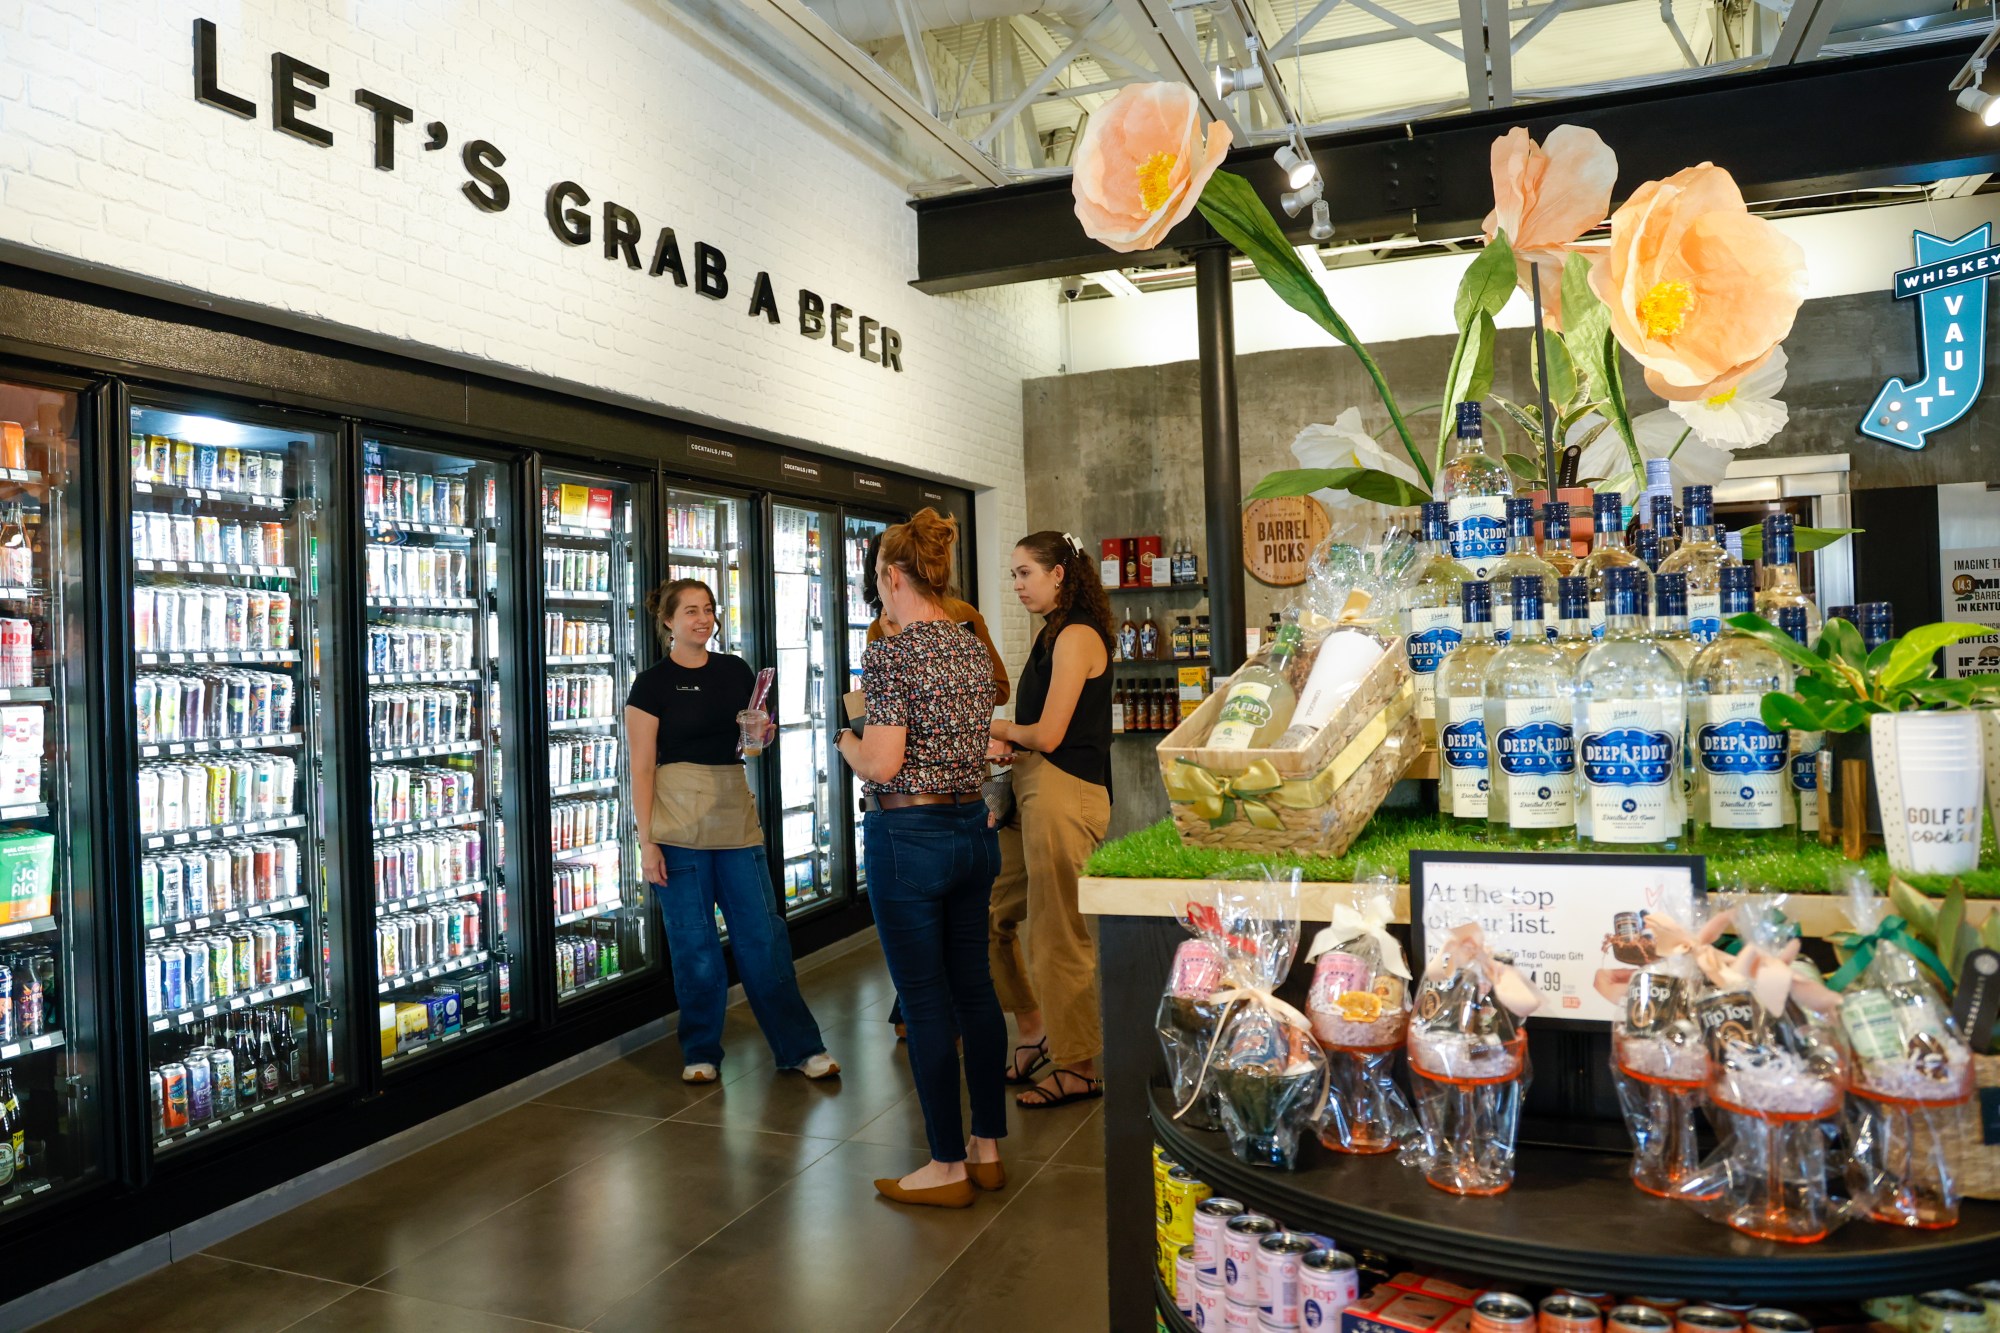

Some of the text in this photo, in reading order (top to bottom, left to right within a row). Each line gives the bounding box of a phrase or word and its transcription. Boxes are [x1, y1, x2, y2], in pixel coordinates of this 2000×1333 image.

[193, 17, 904, 372] LET'S GRAB A BEER
[1903, 254, 2000, 289] WHISKEY
[1915, 294, 1965, 417] VAULT
[690, 443, 718, 455] COCKTAILS
[784, 463, 806, 474] COCKTAILS
[1257, 519, 1311, 542] BARREL
[1450, 527, 1507, 542] DEEP EDDY
[1264, 542, 1306, 565] PICKS
[1454, 543, 1505, 552] VODKA
[1954, 559, 1990, 571] IMAGINE
[1956, 579, 1973, 591] 14.3
[1957, 603, 1967, 613] IN
[1410, 641, 1437, 655] DEEP
[1958, 657, 1976, 667] IF
[1241, 701, 1267, 717] EDDY
[1447, 734, 1476, 747] DEEP
[1503, 737, 1575, 753] DEEP EDDY
[1704, 734, 1784, 751] DEEP EDDY
[1586, 744, 1669, 761] DEEP EDDY
[1711, 755, 1780, 764] VODKA
[1510, 756, 1573, 766] VODKA
[1797, 762, 1817, 774] DEE
[1592, 765, 1664, 775] VODKA
[1907, 807, 1953, 826] GOLF
[16, 866, 40, 883] Jai
[11, 881, 39, 898] Alai
[1428, 883, 1555, 910] At the top
[1509, 912, 1556, 935] list.
[1522, 950, 1538, 961] Top
[1539, 950, 1567, 961] Coupe
[1568, 952, 1584, 962] Gift
[1701, 1003, 1753, 1029] Tip Top
[1229, 1244, 1250, 1264] Top
[1312, 1284, 1337, 1303] Top
